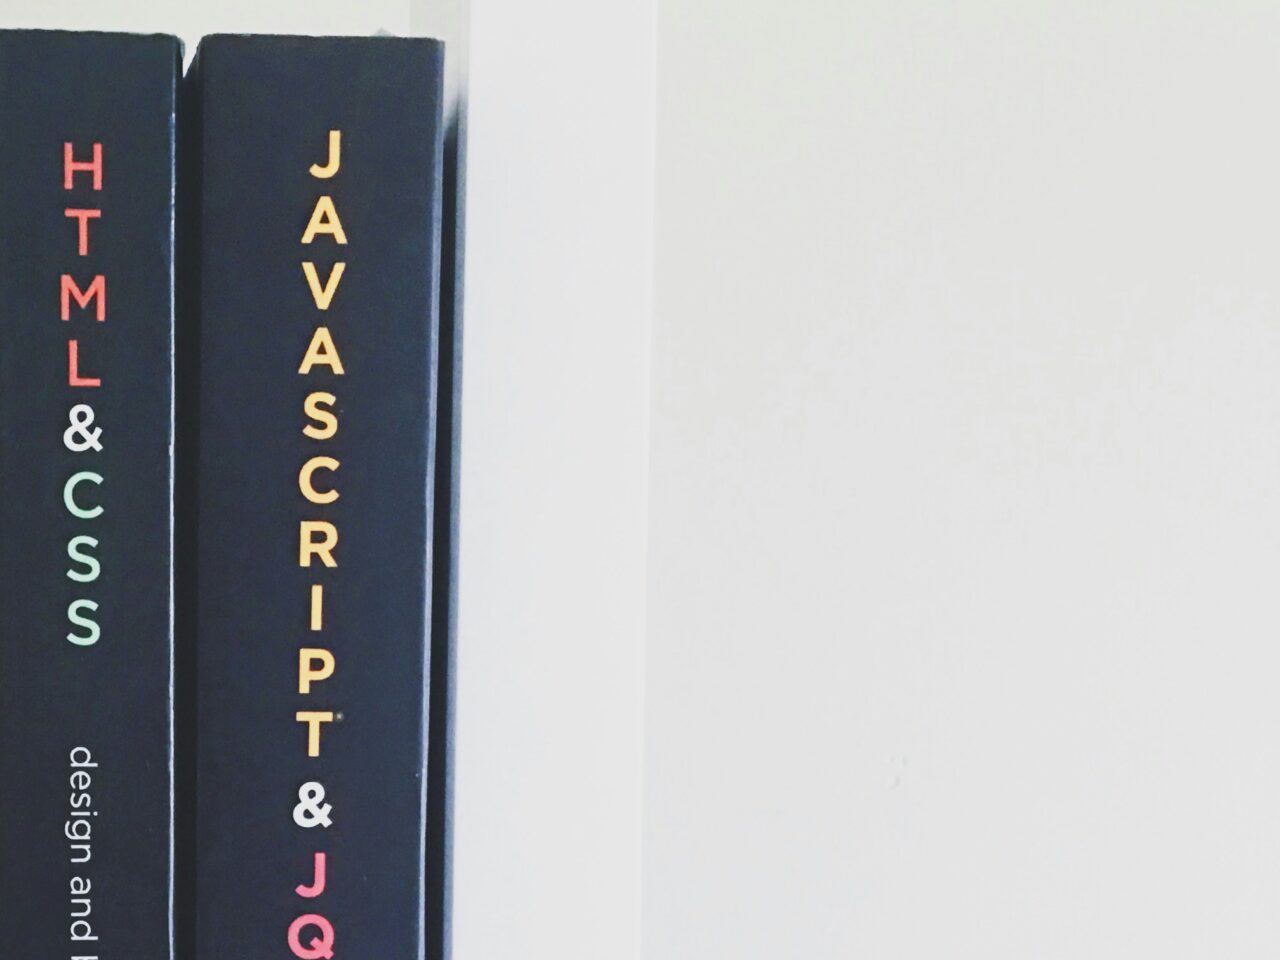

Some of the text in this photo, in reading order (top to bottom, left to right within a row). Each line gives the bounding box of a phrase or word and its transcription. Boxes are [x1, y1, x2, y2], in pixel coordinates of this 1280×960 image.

[59, 141, 107, 388] HTML
[295, 128, 349, 758] JAVASCRIPT
[62, 470, 105, 648] CSS
[64, 746, 99, 864] design
[292, 781, 334, 829] &
[69, 876, 99, 941] and
